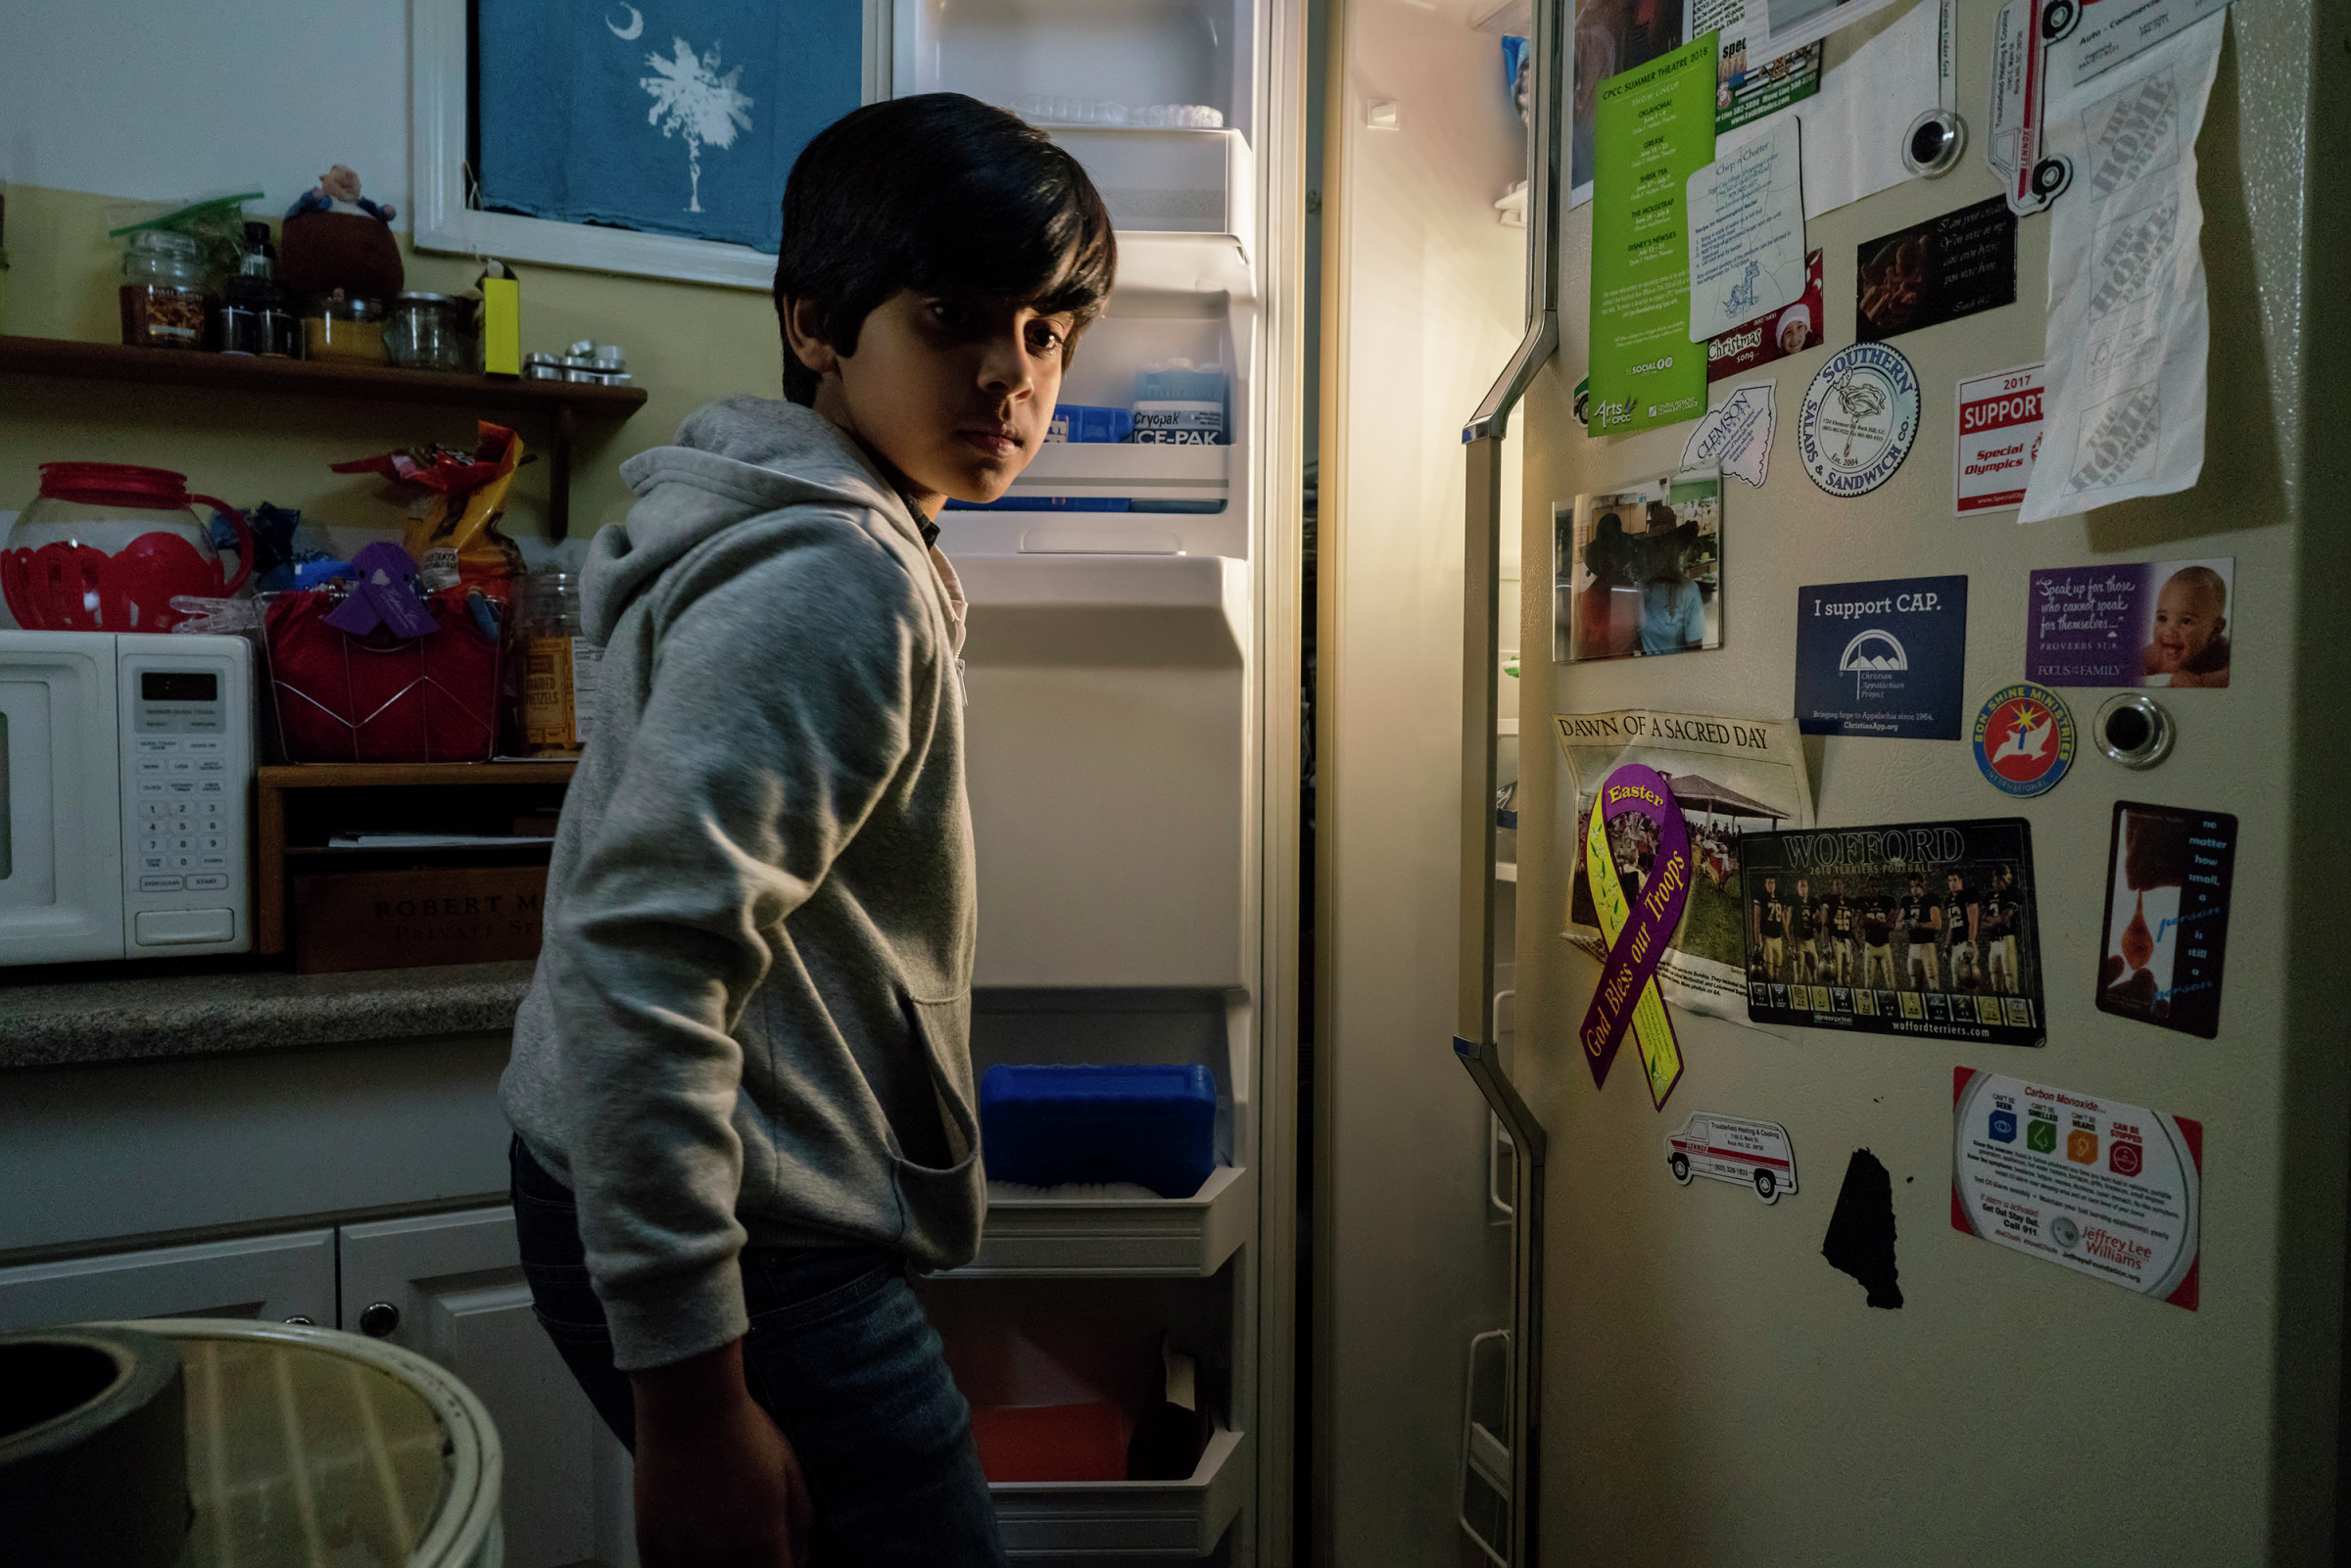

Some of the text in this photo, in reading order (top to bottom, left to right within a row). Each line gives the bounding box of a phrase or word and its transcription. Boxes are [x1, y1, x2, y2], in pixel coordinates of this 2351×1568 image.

[1996, 10, 2010, 80] Heating Cooling
[2080, 29, 2101, 45] Auto
[1603, 46, 1709, 100] CPCC SUMMER THEATRE 2018
[1632, 81, 1680, 107] SHOW LINEUP
[1638, 100, 1672, 118] OKLAHOMA!
[2097, 100, 2134, 148] THE
[1643, 136, 1664, 149] GREASE
[2091, 74, 2175, 195] HOME
[2127, 105, 2178, 182] DEPOT
[1743, 142, 1769, 162] Chatter
[2021, 129, 2032, 166] LENNOX
[1631, 198, 1674, 217] THE MOUSETRAP
[1627, 230, 1677, 252] DISNEY'S NEWSIES
[1940, 229, 1980, 252] You were
[2102, 223, 2135, 267] THE
[2091, 203, 2175, 314] HOME
[2122, 227, 2175, 303] DEPOT
[1943, 274, 1958, 287] you
[1708, 328, 1761, 360] Christmas
[1822, 349, 1913, 395] SOUTHERN
[2003, 374, 2032, 391] 2017
[1133, 411, 1179, 428] Cryopak
[1595, 399, 1623, 429] Arts
[1611, 413, 1631, 427] CPCC
[1696, 392, 1750, 460] CLEMSON
[2086, 407, 2117, 450] THE
[1802, 400, 1909, 491] SALADS & SANDWICH CO.
[2068, 387, 2158, 491] HOME
[1831, 451, 1858, 467] Est. 2004
[1976, 443, 2024, 461] Special
[2102, 419, 2159, 486] DEPOT
[1964, 457, 2024, 476] Olympics
[2074, 586, 2086, 599] up
[2088, 578, 2104, 601] for
[2105, 575, 2135, 593] those
[1814, 593, 1942, 619] I support CAP.
[2041, 594, 2128, 616] who cannot speak
[2039, 616, 2056, 639] for
[2040, 641, 2092, 650] PROVERBS
[1861, 672, 1893, 682] Christian
[2038, 665, 2070, 676] FOCUS
[2080, 664, 2120, 676] FAMILY
[1861, 681, 1905, 690] Appalachian
[1861, 689, 1884, 698] Project
[1813, 710, 1839, 721] Bringing
[1840, 712, 1854, 722] hope
[1862, 711, 1897, 722] Appalachia
[1974, 687, 2071, 761] SON SHINE MINISTRIES
[1558, 715, 1768, 750] DAWN OF A SACRED DAY
[1844, 721, 1898, 732] ChristianApp.org
[1986, 768, 2047, 792] INTERNATIONAL
[1607, 784, 1665, 809] Easter
[179, 804, 185, 813] 2
[209, 803, 216, 812] 3
[150, 823, 156, 832] 4
[180, 822, 186, 831] 5
[210, 822, 216, 831] 6
[2202, 821, 2217, 830] no
[150, 839, 156, 849] 7
[180, 839, 186, 848] 8
[210, 838, 216, 847] 9
[1782, 828, 1964, 869] WOFFORD
[2188, 837, 2228, 850] matter
[180, 857, 187, 866] 0
[1809, 861, 1934, 876] 2010 TERRIERS FOOTBALL
[2194, 854, 2219, 866] how
[2188, 874, 2221, 887] small,
[2198, 893, 2207, 902] a
[376, 895, 503, 919] ROBERT
[1767, 902, 1782, 922] 78
[1834, 907, 1849, 931] 46
[2157, 906, 2220, 943] person
[2194, 929, 2203, 940] is
[1586, 849, 1685, 1057] God Bless our Troops
[2187, 948, 2207, 960] still
[2191, 967, 2199, 976] a
[2151, 980, 2213, 1014] person
[1893, 1022, 1991, 1038] woffordterriers.com
[1991, 1093, 2007, 1104] CAN'T
[2024, 1086, 2055, 1102] Carbon
[1994, 1101, 2012, 1112] SEEN
[2030, 1102, 2046, 1112] CAN'T
[2028, 1109, 2058, 1123] SMELLED
[2070, 1112, 2086, 1121] CAN'T
[2071, 1119, 2096, 1131] HEARD
[1711, 1122, 1737, 1133] Troublefield
[1738, 1126, 1755, 1136] Heating
[1761, 1128, 1780, 1140] Cooling
[2109, 1128, 2142, 1144] STOPPED
[2112, 1121, 2139, 1135] CAN BE
[1687, 1142, 1707, 1153] LENNOX
[1714, 1164, 1726, 1172] (803)
[1985, 1194, 2001, 1206] alarm
[2009, 1185, 2063, 1209] monthly Maintain
[1981, 1203, 2039, 1228] Get Out Stay Out.
[2002, 1218, 2037, 1237] Call 911
[2081, 1226, 2126, 1251] Jeffrey
[2128, 1242, 2152, 1261] Lee
[2085, 1243, 2141, 1271] Williams
[2061, 1251, 2141, 1284] JeffreysFoundation.org
